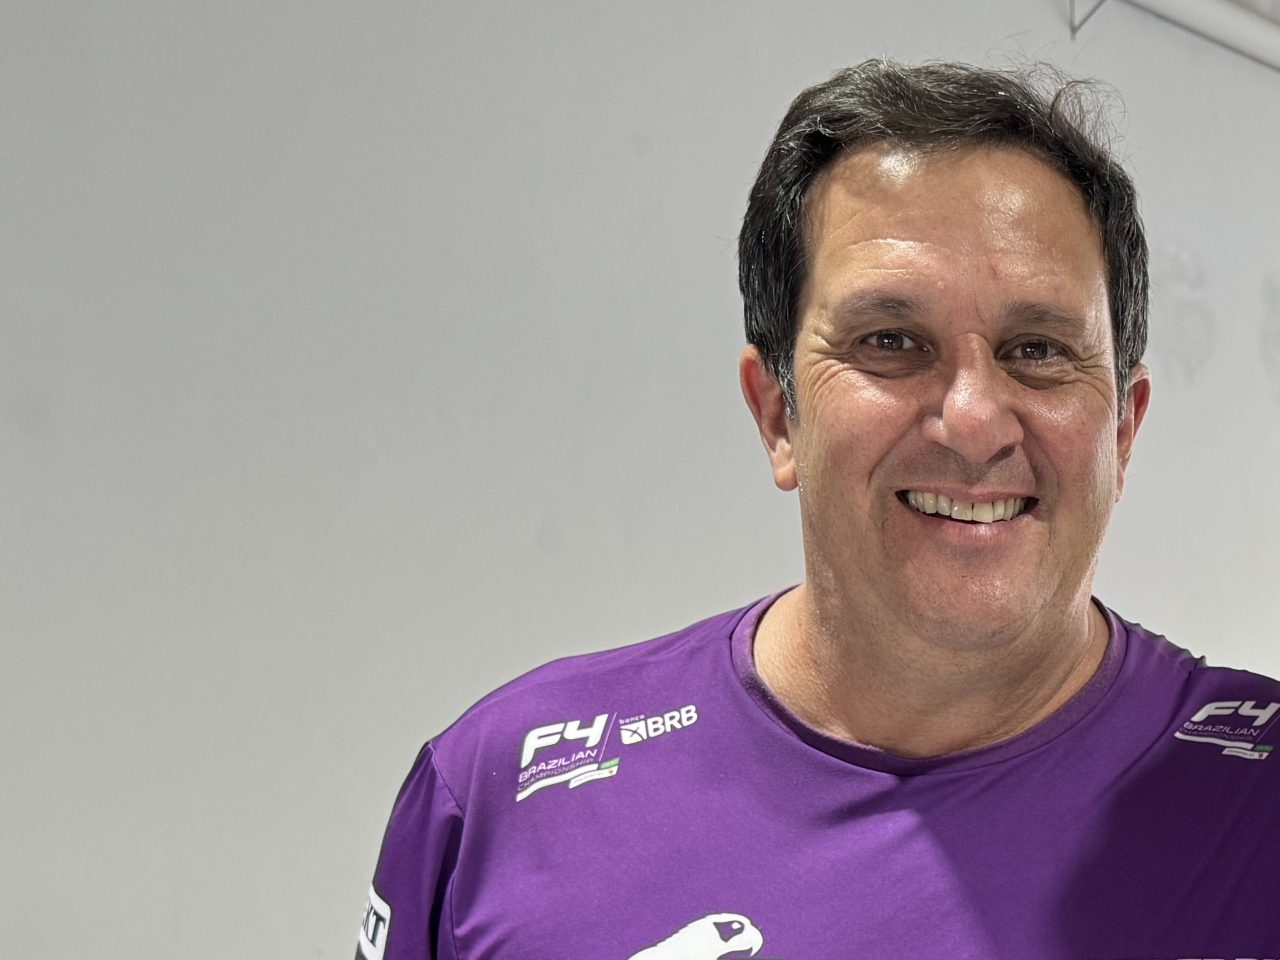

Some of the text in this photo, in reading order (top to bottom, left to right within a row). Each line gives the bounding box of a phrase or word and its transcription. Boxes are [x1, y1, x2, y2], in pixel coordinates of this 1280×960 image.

[647, 704, 698, 737] BRB
[1183, 721, 1260, 737] BRAZILIAN
[521, 714, 609, 768] F4
[518, 749, 598, 784] BRAZILIAN
